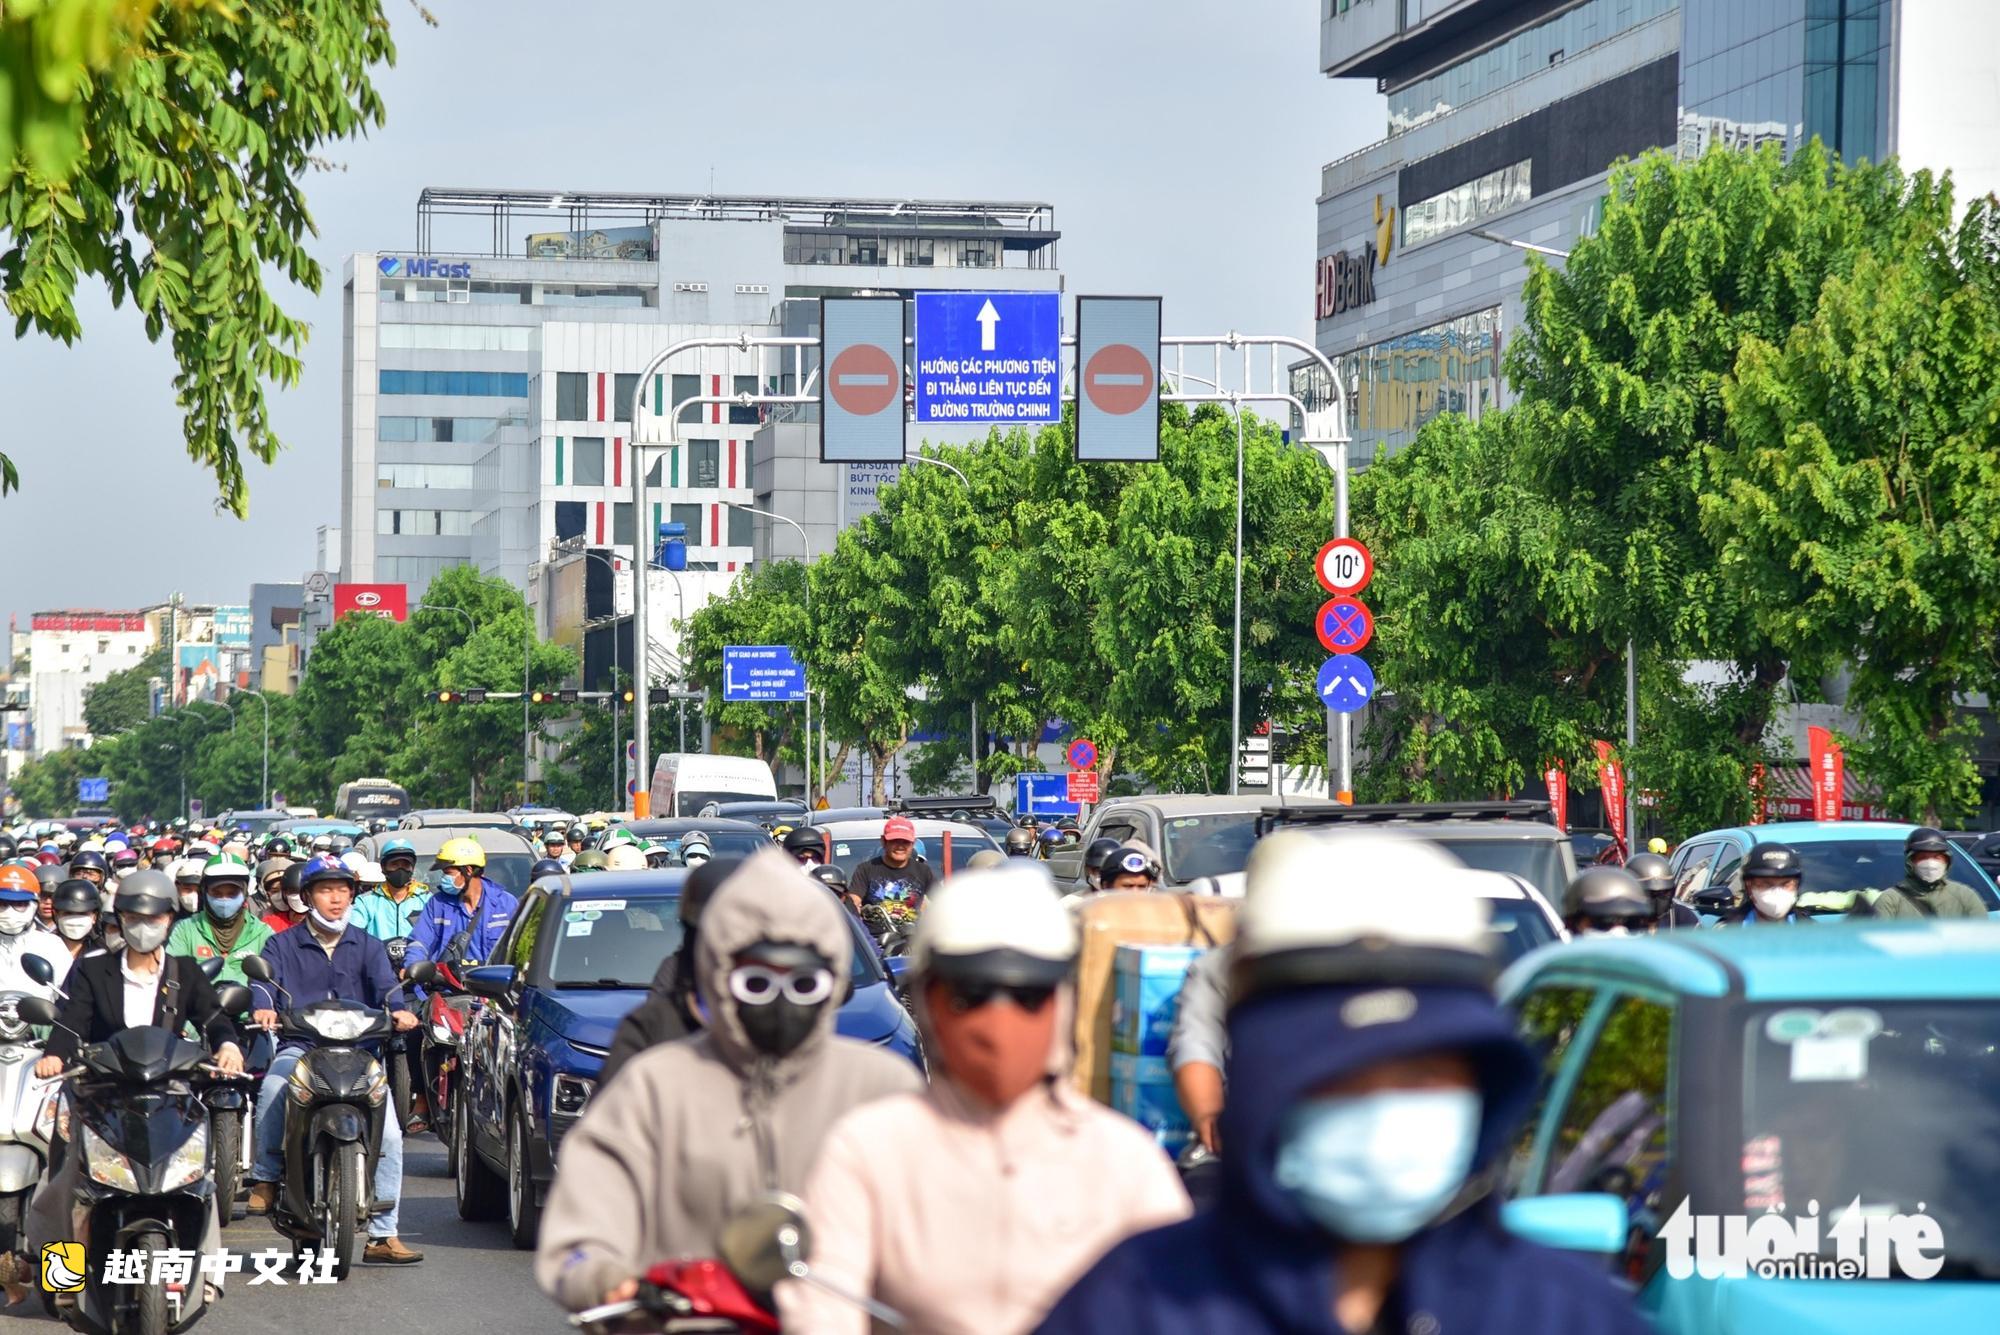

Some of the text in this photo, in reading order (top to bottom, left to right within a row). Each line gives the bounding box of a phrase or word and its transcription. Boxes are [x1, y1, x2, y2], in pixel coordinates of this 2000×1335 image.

[406, 258, 471, 279] MFast
[1315, 240, 1376, 321] HDBank
[921, 356, 1056, 376] HƯỚNG CÁC PHƯƠNG TIỆN
[926, 375, 1051, 398] ĐI THẲNG LIÊN TỤC ĐẾN
[930, 399, 1051, 417] ĐƯỜNG TRƯỜNG CHINH
[850, 487, 875, 495] KINH
